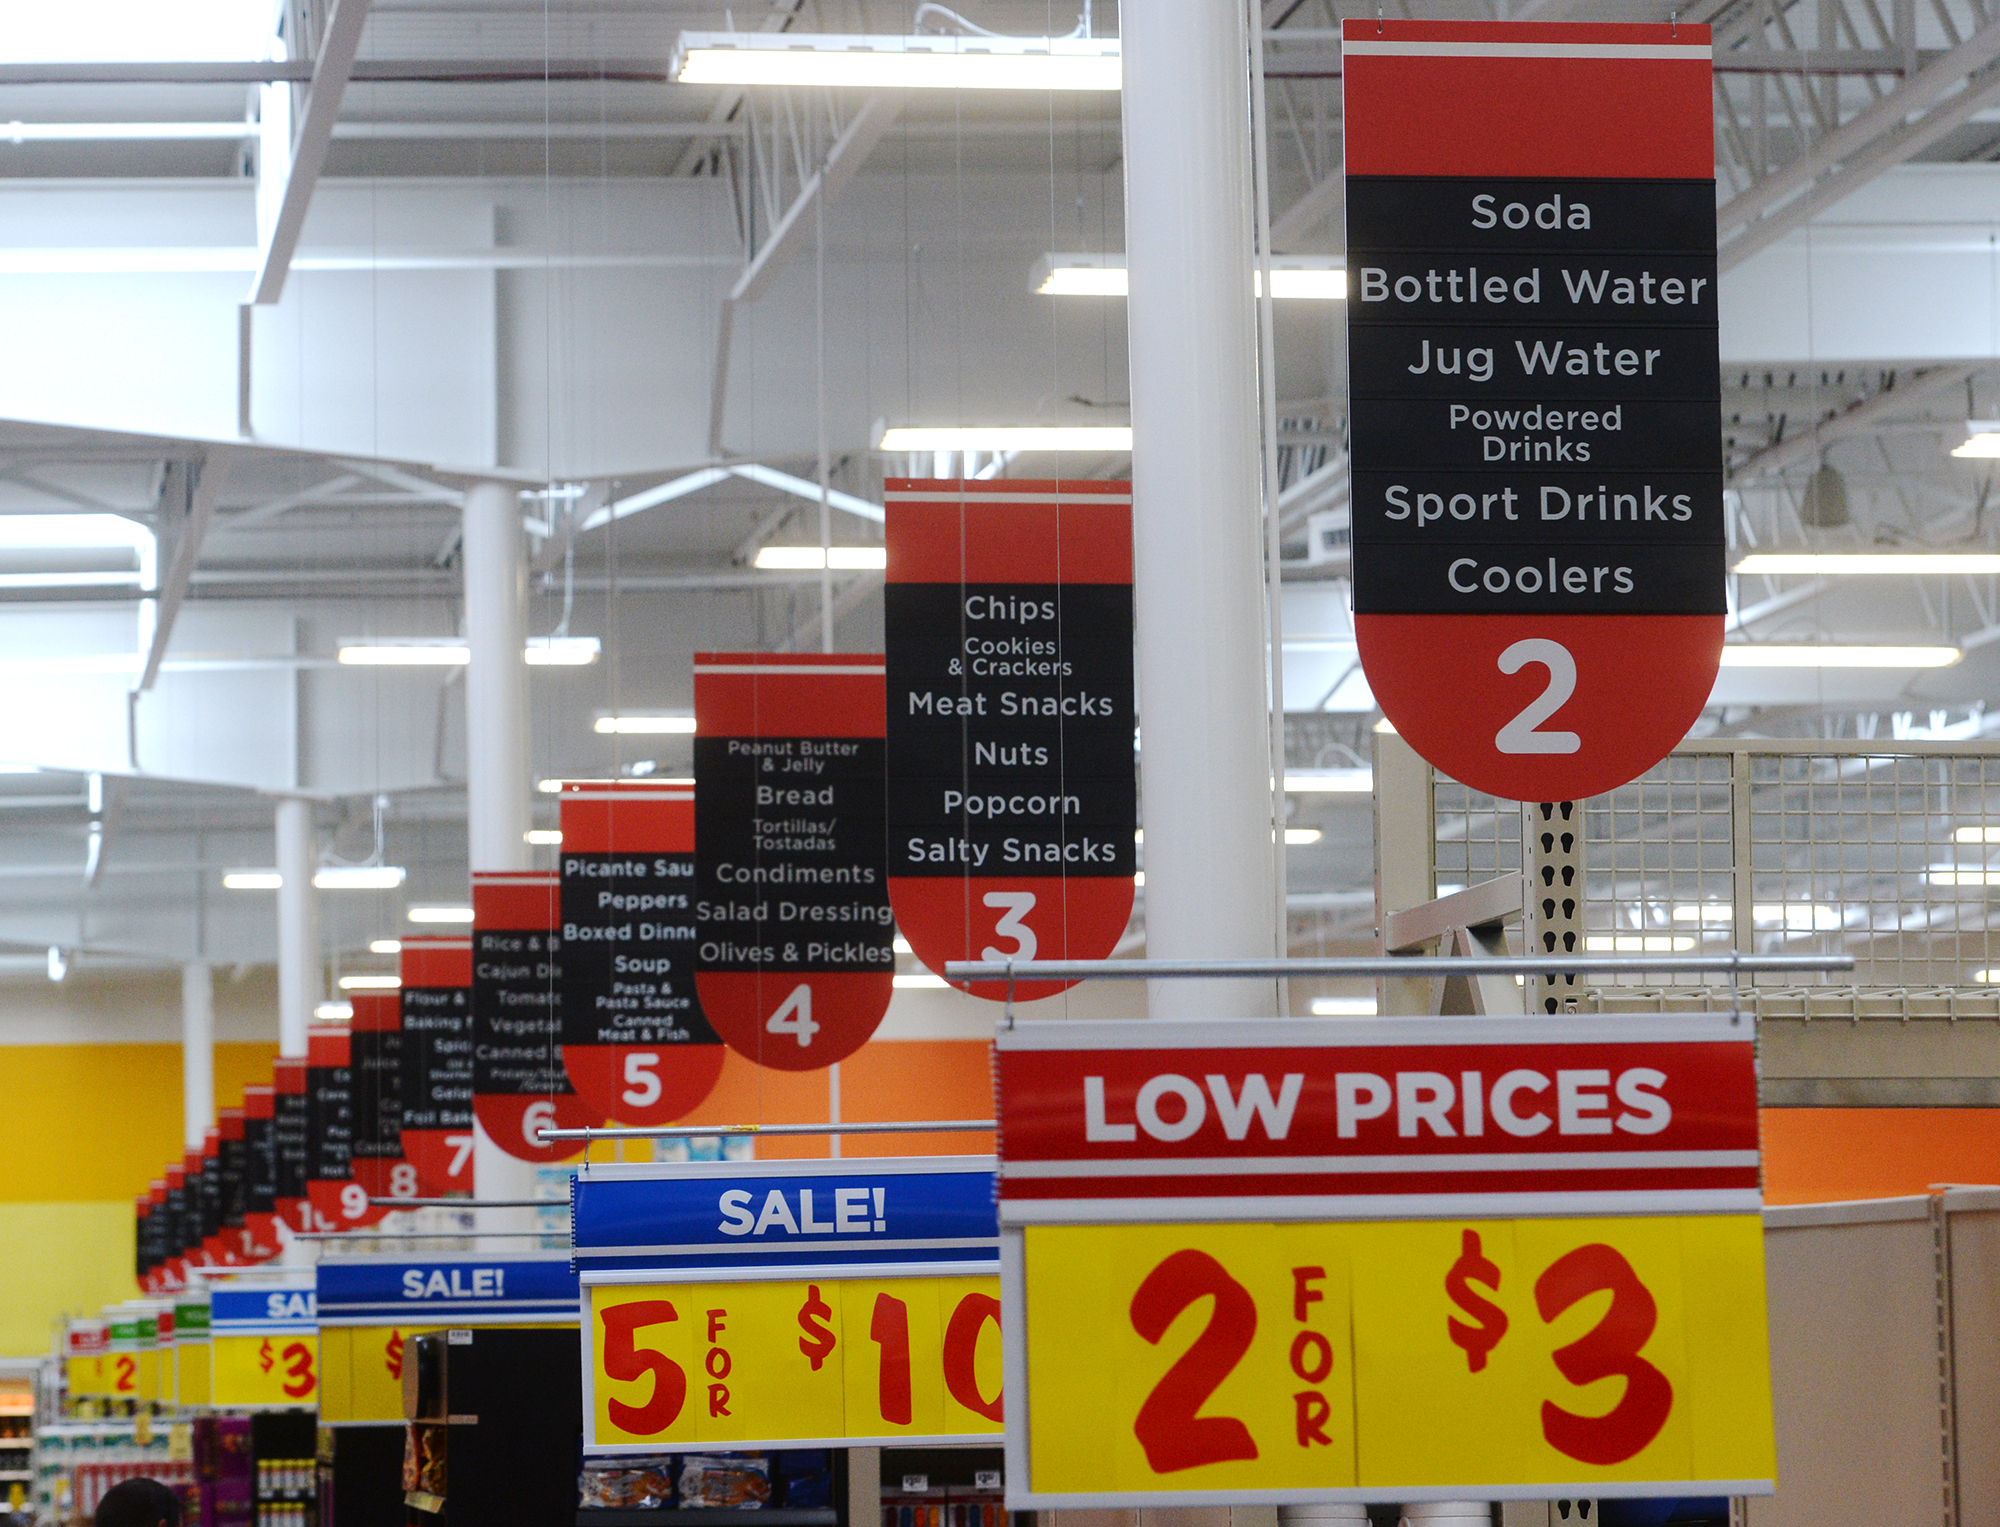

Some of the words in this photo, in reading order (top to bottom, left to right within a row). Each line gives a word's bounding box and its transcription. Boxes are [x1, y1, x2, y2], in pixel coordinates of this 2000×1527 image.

[1471, 193, 1592, 230] Soda
[1359, 267, 1540, 304] Bottled
[1561, 269, 1707, 305] Water
[1407, 339, 1494, 382] Jug
[1514, 340, 1661, 376] Water
[1449, 403, 1622, 431] Powdered
[1483, 435, 1591, 462] Drinks
[1384, 484, 1519, 528] Sport
[1540, 485, 1693, 522] Drinks
[1447, 557, 1634, 594] Coolers
[964, 595, 1056, 622] Chips
[964, 637, 1056, 657] Cookies
[947, 657, 963, 676] &
[972, 657, 1073, 677] Crackers
[909, 692, 987, 716] Meat
[1000, 691, 1113, 716] Snacks
[1495, 638, 1581, 754] 2
[728, 740, 793, 756] Peanut
[800, 741, 859, 756] Butter
[975, 741, 1049, 766] Nuts
[762, 757, 775, 772] &
[782, 758, 825, 775] Jelly
[756, 785, 834, 806] Bread
[944, 790, 1080, 819] Popcorn
[753, 818, 837, 837] Tortillas/
[753, 835, 836, 851] Tostadas
[908, 837, 989, 866] Salty
[1003, 837, 1116, 862] Snacks
[565, 859, 647, 877] Picante
[716, 862, 875, 884] Condiments
[598, 891, 688, 912] Peppers
[696, 901, 768, 922] Salad
[779, 901, 893, 926] Dressing
[563, 923, 632, 941] Boxed
[980, 892, 1038, 962] 3
[481, 935, 522, 952] Rice
[700, 942, 775, 963] Olives
[782, 942, 799, 963] &
[807, 942, 892, 963] Pickles
[614, 954, 671, 975] Soup
[613, 981, 657, 996] Pasta
[660, 981, 672, 996] &
[595, 995, 639, 1010] Pasta
[643, 995, 690, 1010] Sauce
[766, 984, 820, 1047] 4
[598, 1027, 635, 1042] Meat
[640, 1027, 653, 1042] &
[657, 1027, 690, 1042] Fish
[612, 1014, 674, 1028] Canned
[475, 1043, 547, 1060] Canned
[622, 1053, 662, 1106] 5
[1083, 1073, 1304, 1142] LOW
[1334, 1067, 1672, 1139] PRICES
[522, 1101, 558, 1148] 6
[445, 1136, 474, 1176] 7
[390, 1164, 417, 1197] 8
[340, 1184, 367, 1219] 9
[717, 1187, 886, 1236] SALE!
[402, 1268, 504, 1298] SALE!
[600, 1300, 687, 1436] 5
[705, 1308, 732, 1418] FOR
[1130, 1249, 1258, 1474] 2
[1290, 1266, 1333, 1448] FOR
